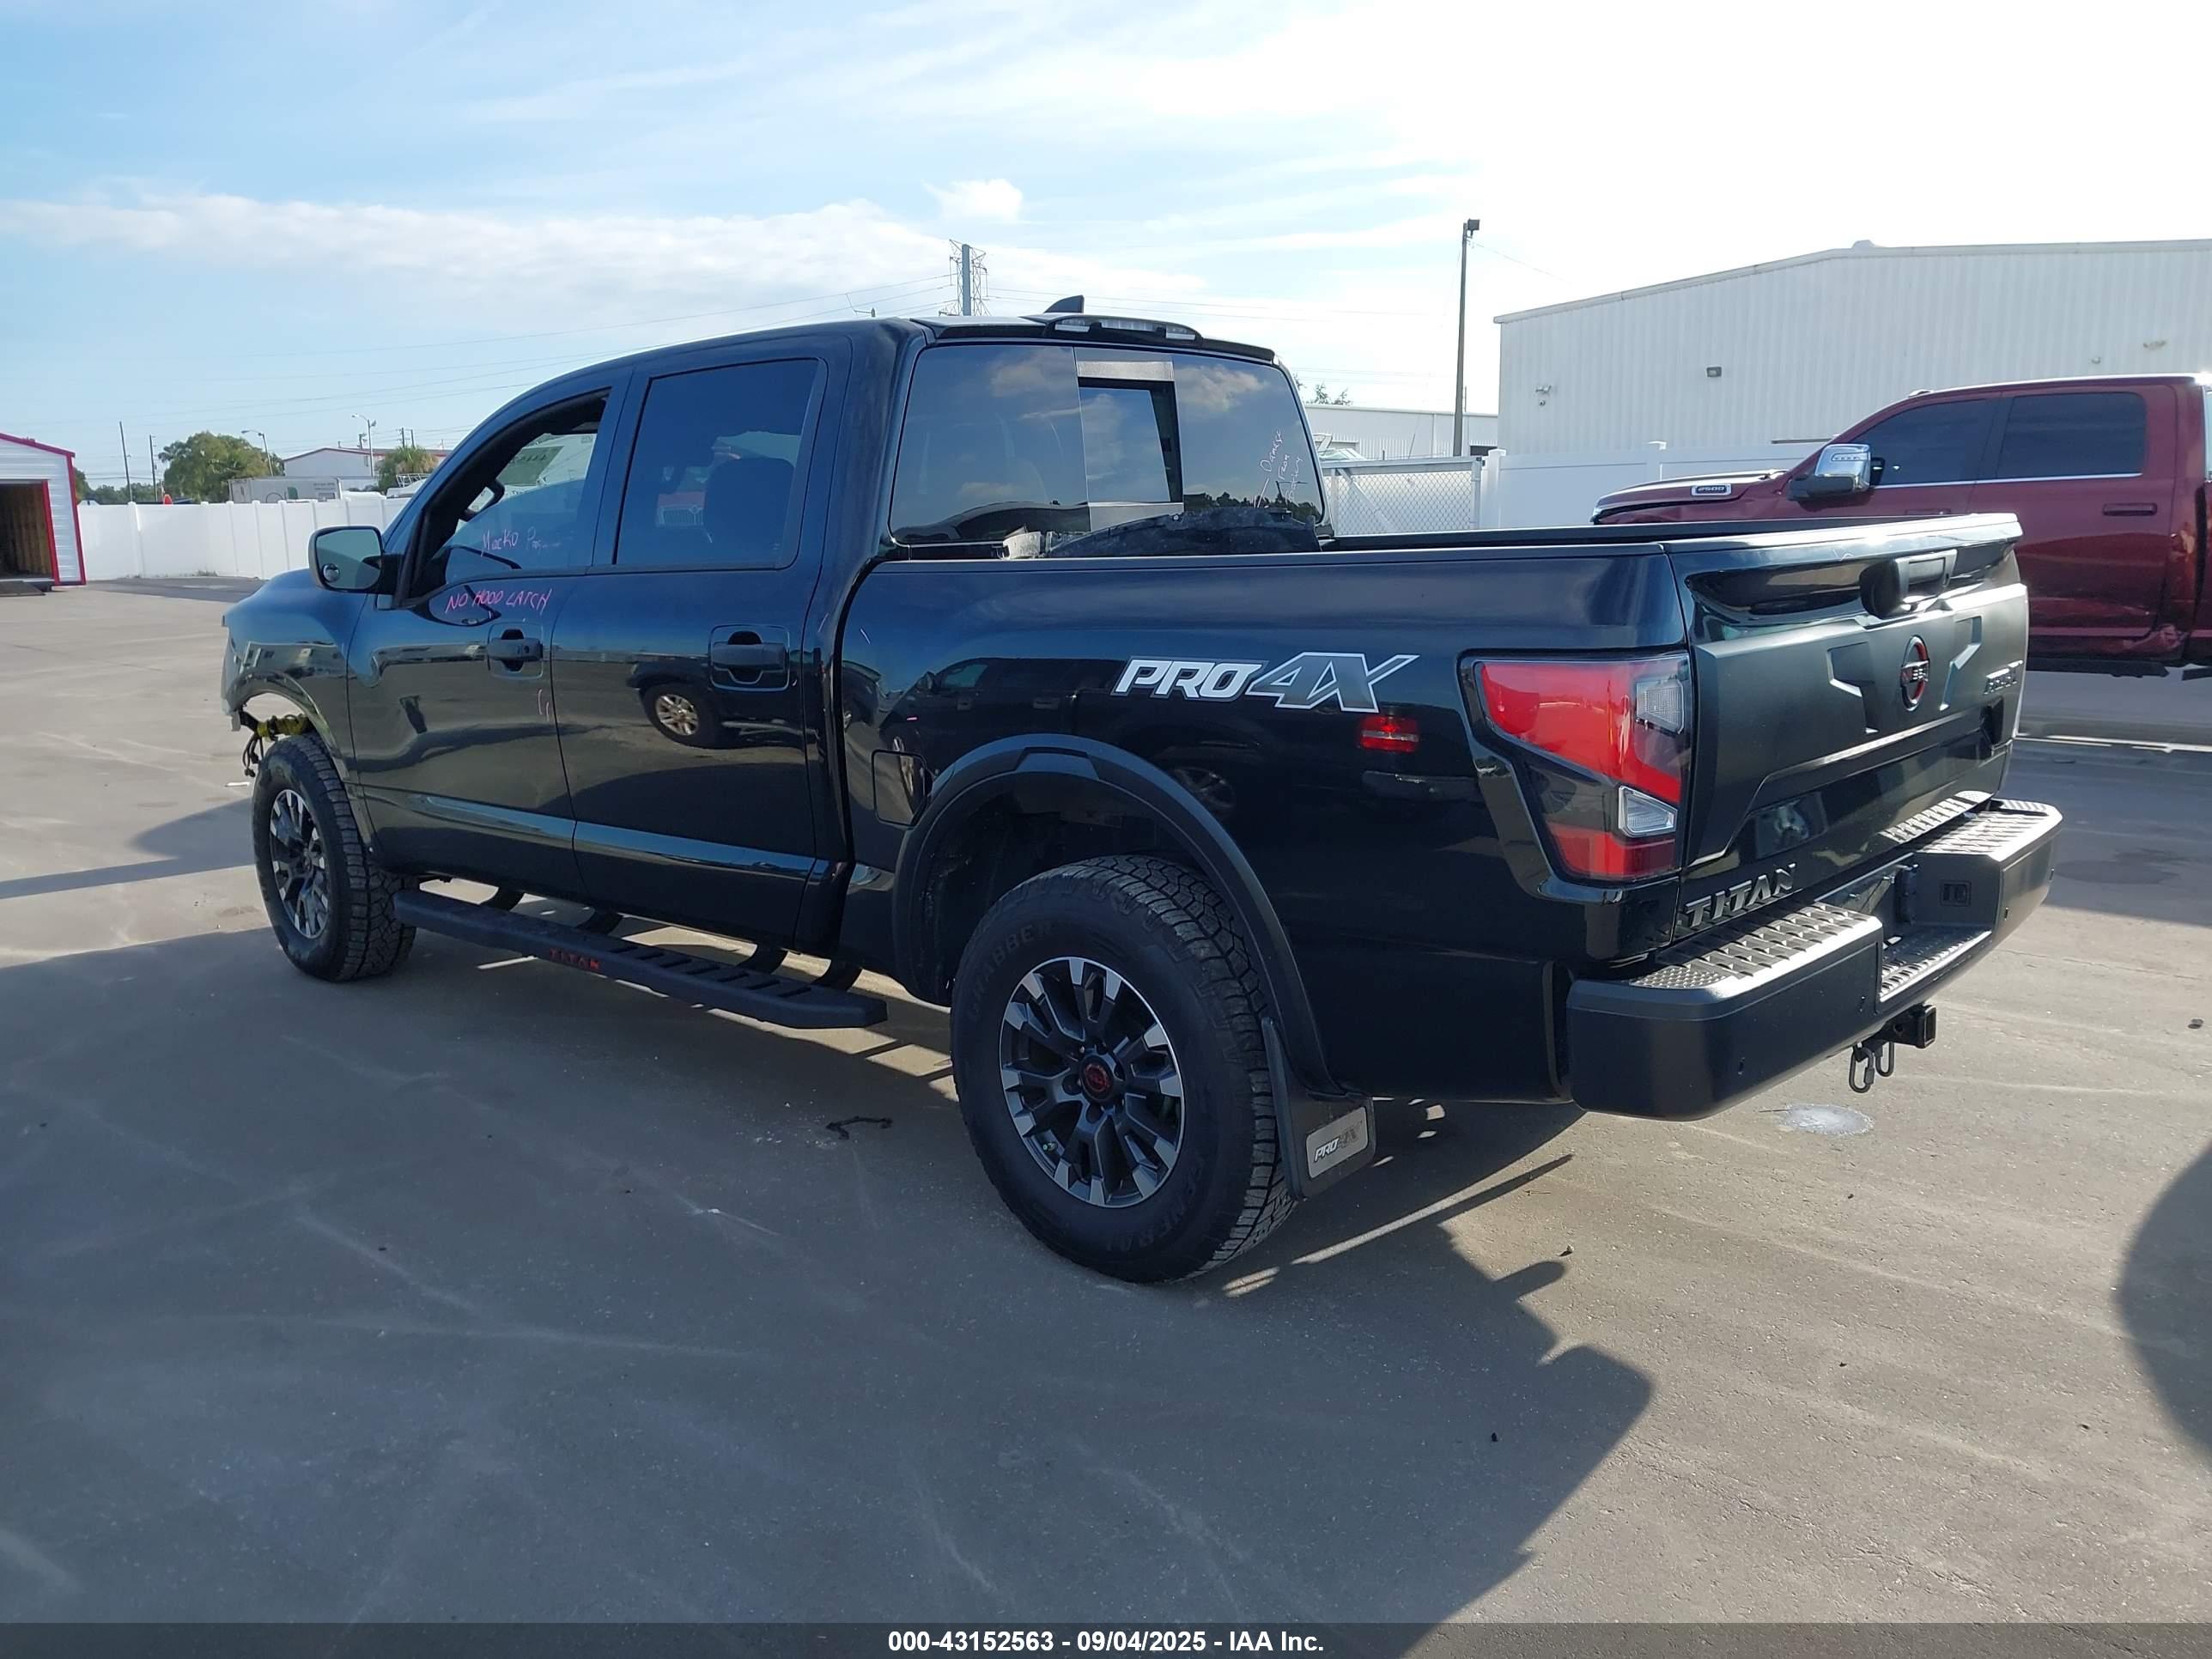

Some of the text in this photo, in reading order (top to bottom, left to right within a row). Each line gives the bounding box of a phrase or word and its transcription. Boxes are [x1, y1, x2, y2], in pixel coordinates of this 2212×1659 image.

[445, 587, 553, 616] NO HOOD LATCH
[1685, 862, 1797, 929] TITAN
